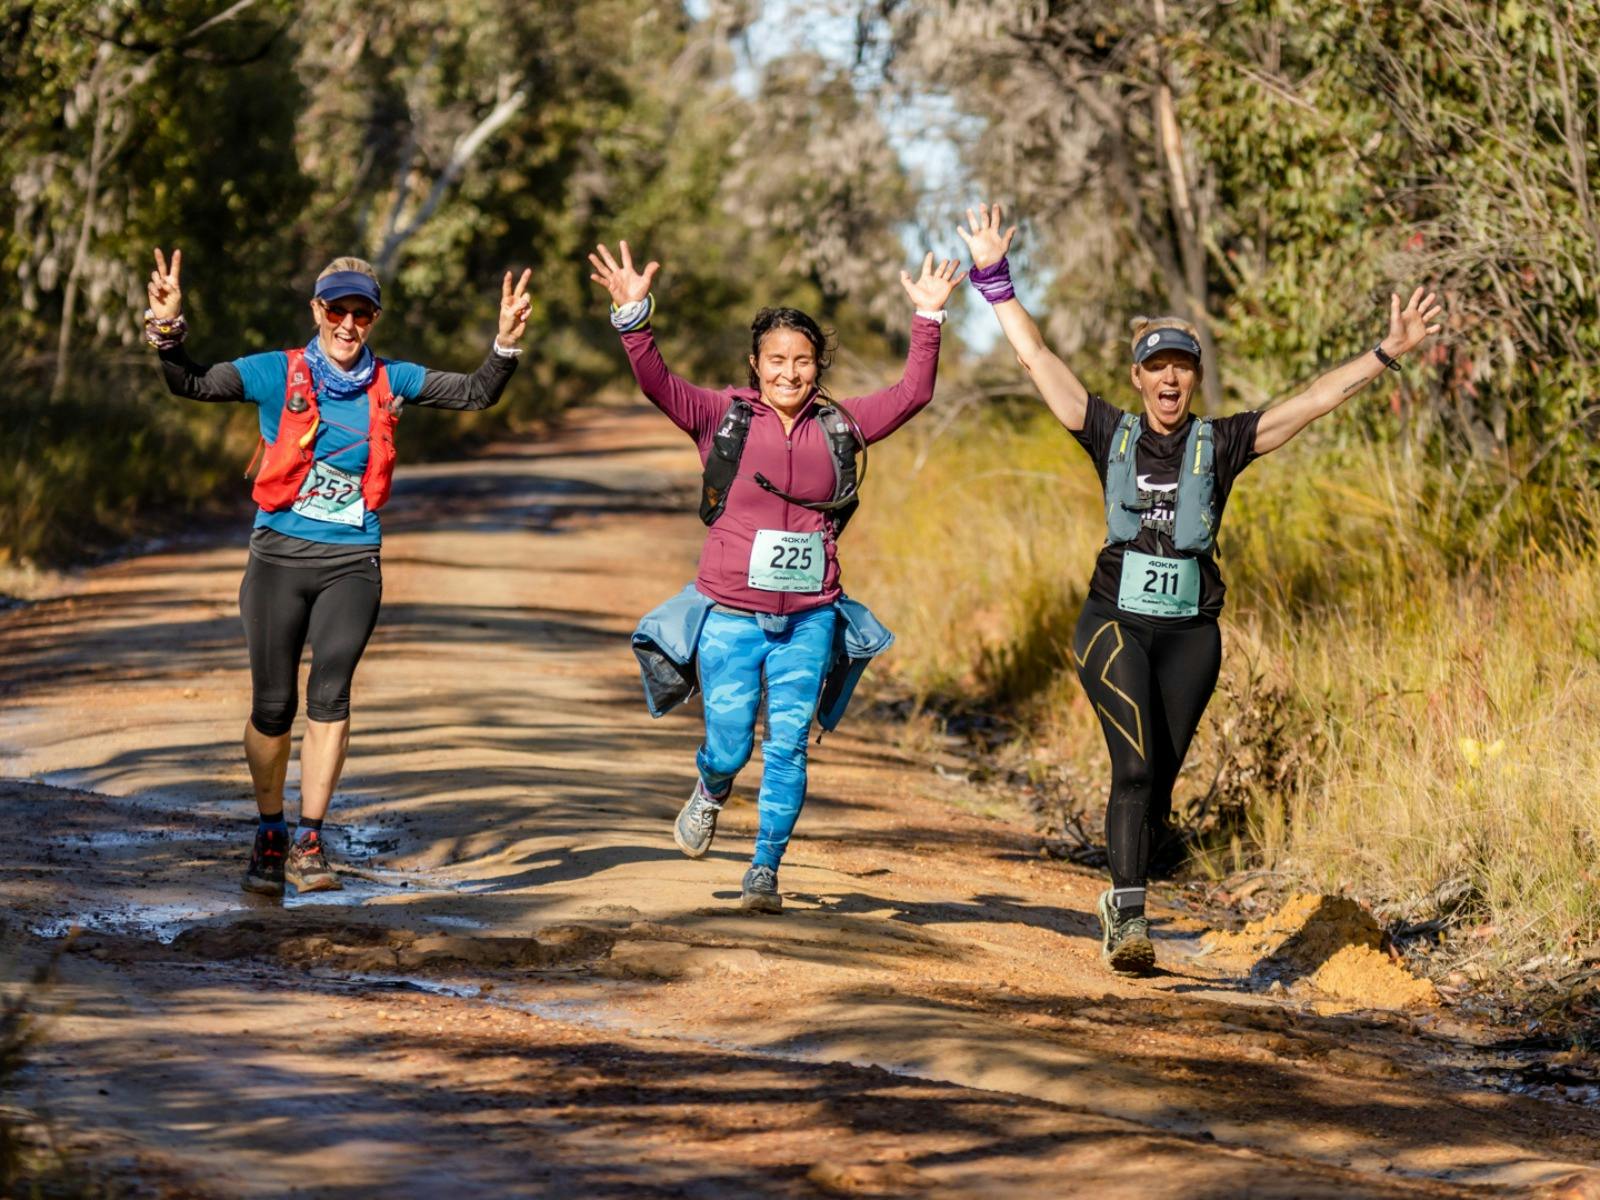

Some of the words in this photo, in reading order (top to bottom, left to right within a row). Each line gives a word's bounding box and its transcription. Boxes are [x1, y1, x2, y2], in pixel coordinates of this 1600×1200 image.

[308, 475, 353, 505] 252
[781, 536, 809, 544] 40KM
[770, 545, 812, 570] 225
[1148, 560, 1178, 570] 40KM
[1143, 569, 1179, 595] 211
